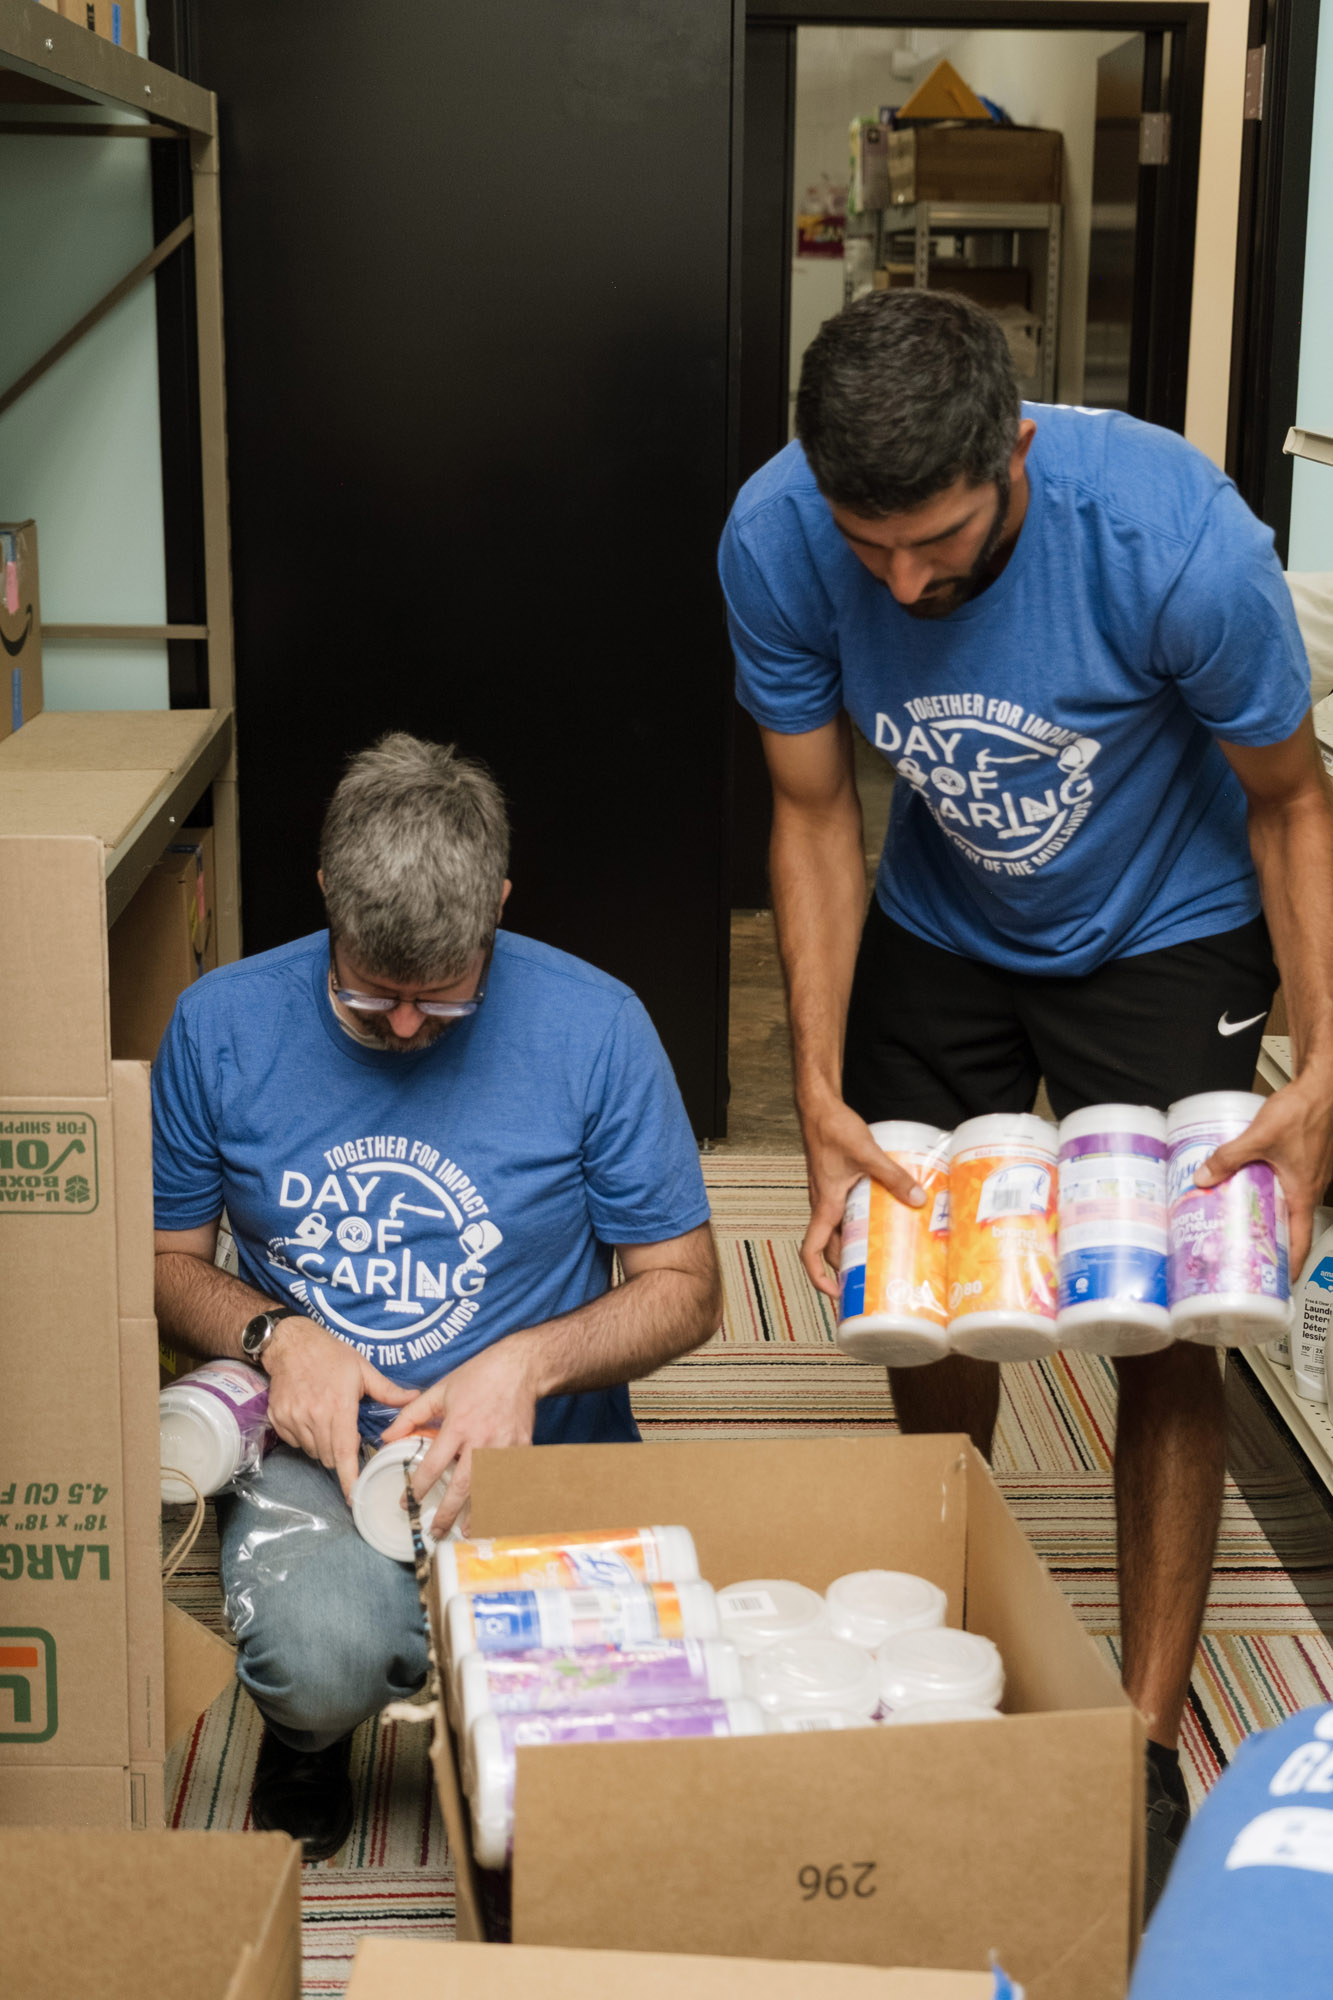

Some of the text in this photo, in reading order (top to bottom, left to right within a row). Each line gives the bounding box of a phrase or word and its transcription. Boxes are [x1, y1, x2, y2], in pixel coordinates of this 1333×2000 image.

[875, 712, 962, 764] DAY
[904, 693, 1083, 746] TOGETHER FOR IMPAC
[930, 766, 998, 799] OF
[939, 772, 1094, 839] ARING
[983, 858, 1002, 873] OF
[1003, 860, 1035, 876] THE
[1034, 800, 1092, 868] MIDLANDS
[56, 1121, 87, 1134] FOR
[279, 1170, 381, 1212] DAY
[323, 1135, 490, 1219] TOGETHER FOR IMPACT
[336, 1216, 405, 1253] OF
[296, 1248, 488, 1315] CARING
[289, 1280, 480, 1366] UNITED OF THE MIDLANDS
[24, 1483, 59, 1505] CU
[67, 1483, 108, 1505] 4.5
[15, 1514, 48, 1531] 18"
[74, 1514, 107, 1531] 18"
[0, 1543, 110, 1581] LARG
[798, 1862, 877, 1901] 296
